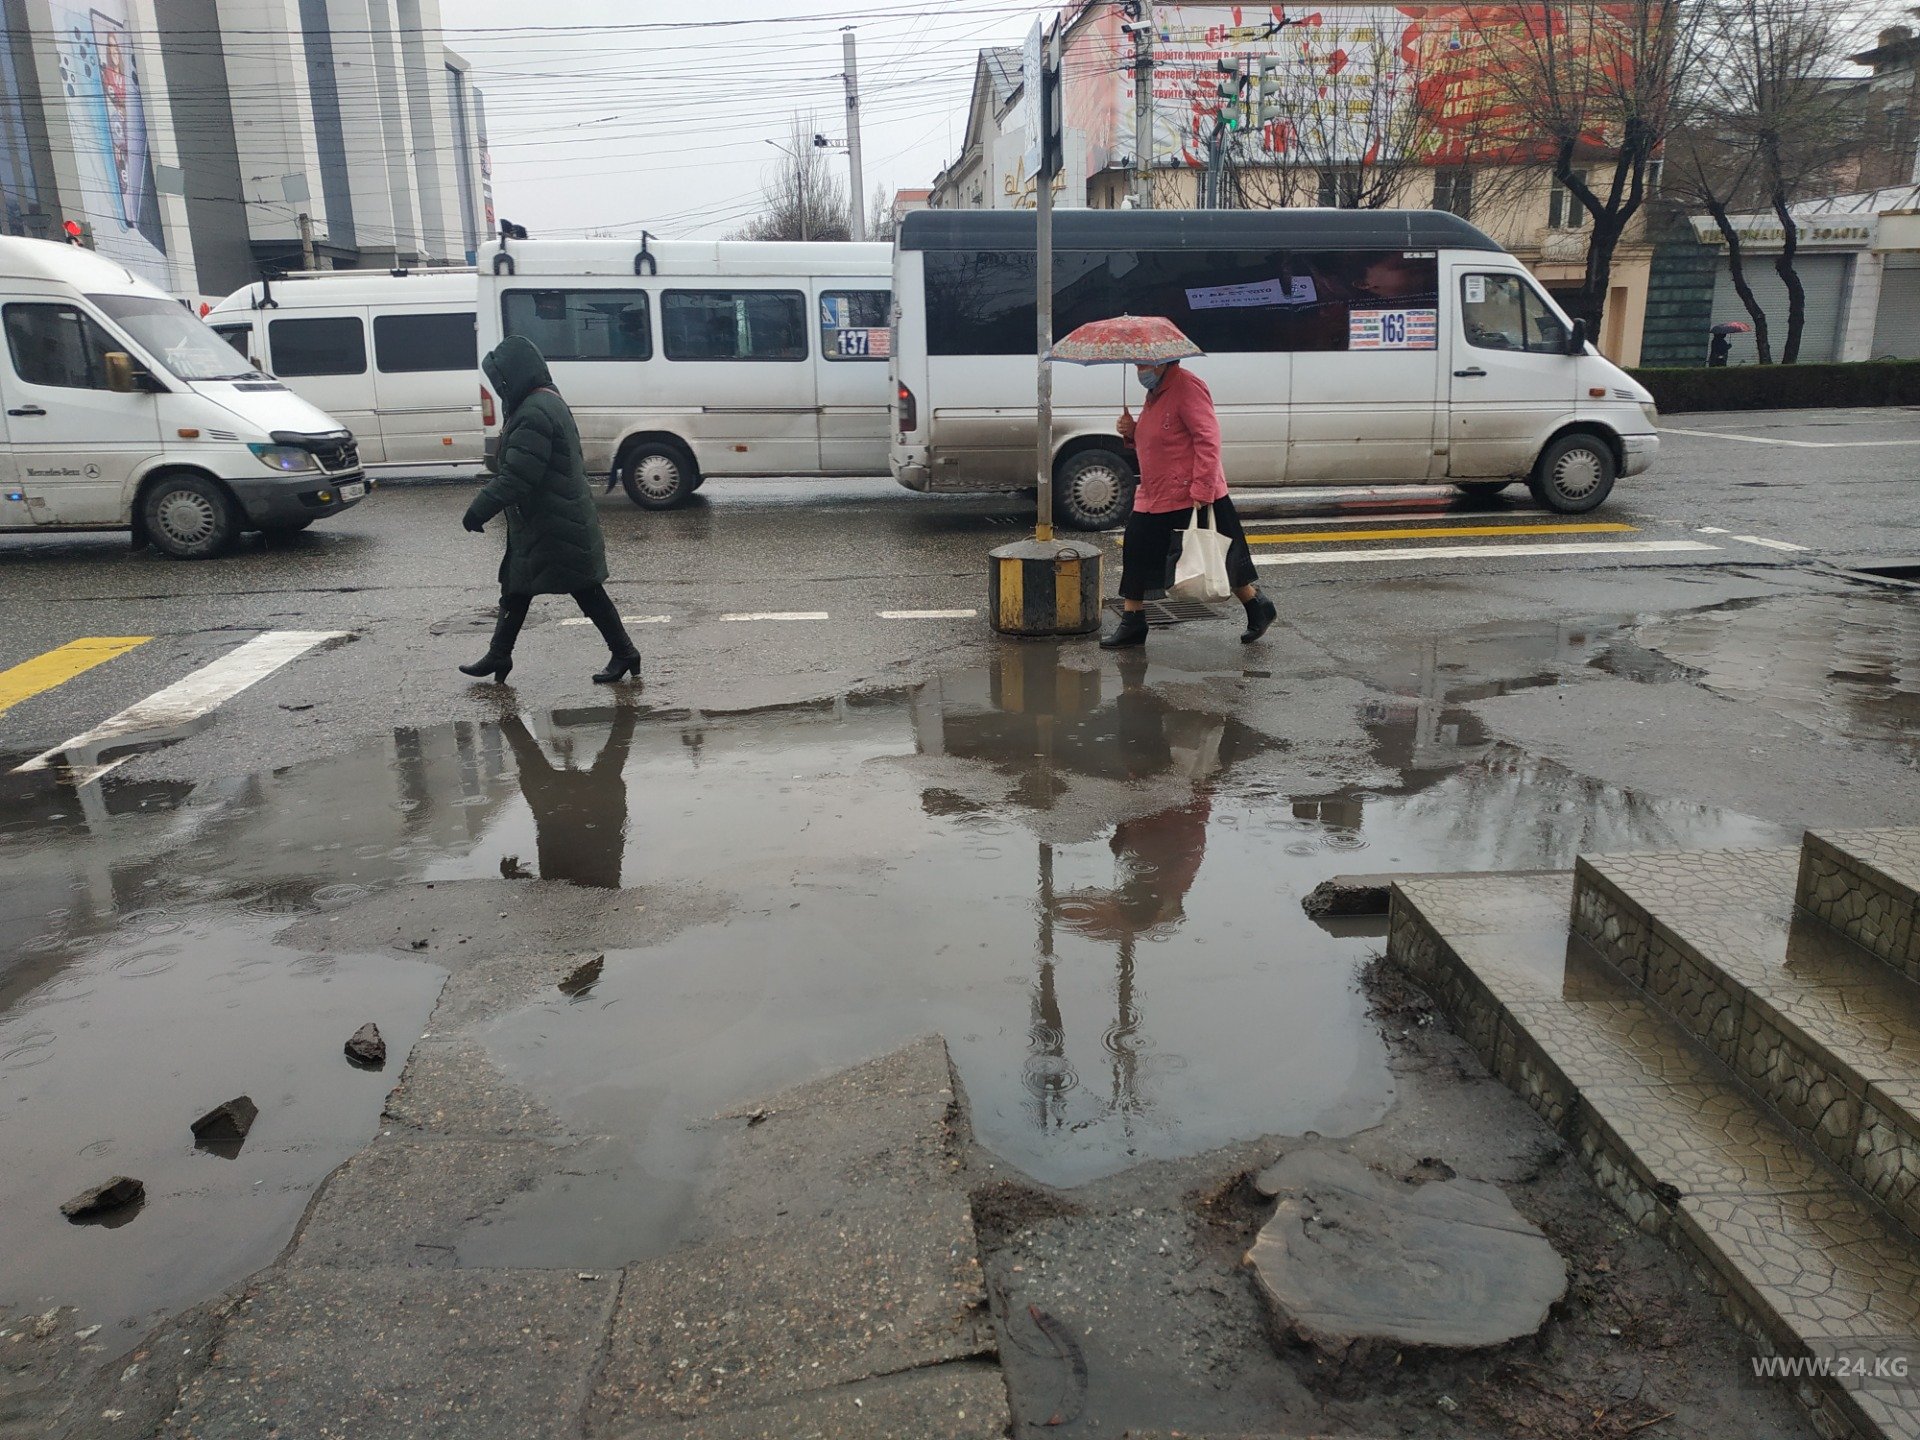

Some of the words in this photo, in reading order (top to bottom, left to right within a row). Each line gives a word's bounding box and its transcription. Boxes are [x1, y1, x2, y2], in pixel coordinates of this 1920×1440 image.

[1185, 51, 1222, 61] покупки
[1381, 313, 1405, 343] 163
[837, 330, 868, 355] 137
[27, 467, 80, 477] Mercedes-Benz
